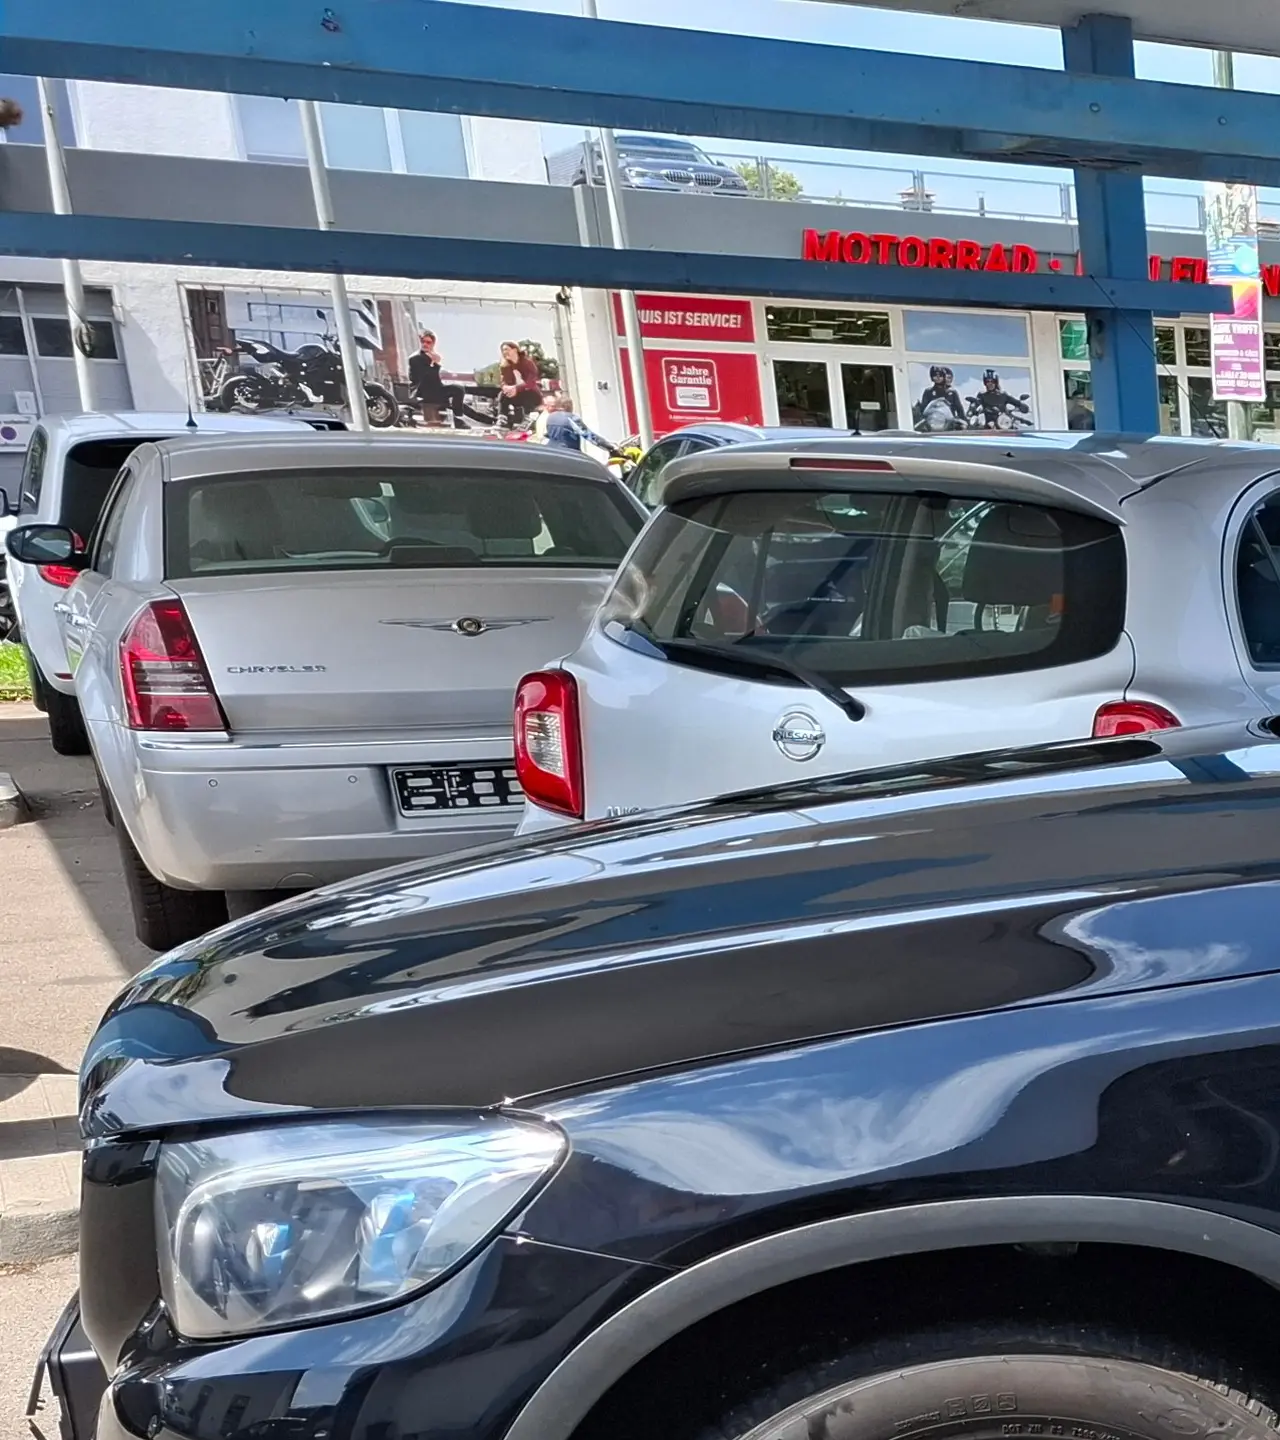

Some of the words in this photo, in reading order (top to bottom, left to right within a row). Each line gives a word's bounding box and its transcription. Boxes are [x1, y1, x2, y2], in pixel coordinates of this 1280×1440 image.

[803, 228, 1037, 273] MOTORRAD
[638, 310, 662, 324] UIS
[664, 311, 684, 325] IST
[685, 312, 742, 328] SERVICE!
[670, 365, 677, 375] 3
[680, 366, 709, 376] Jahre
[670, 375, 712, 385] Garantie
[226, 665, 327, 674] CHRYSLER
[774, 729, 822, 743] NISSAN
